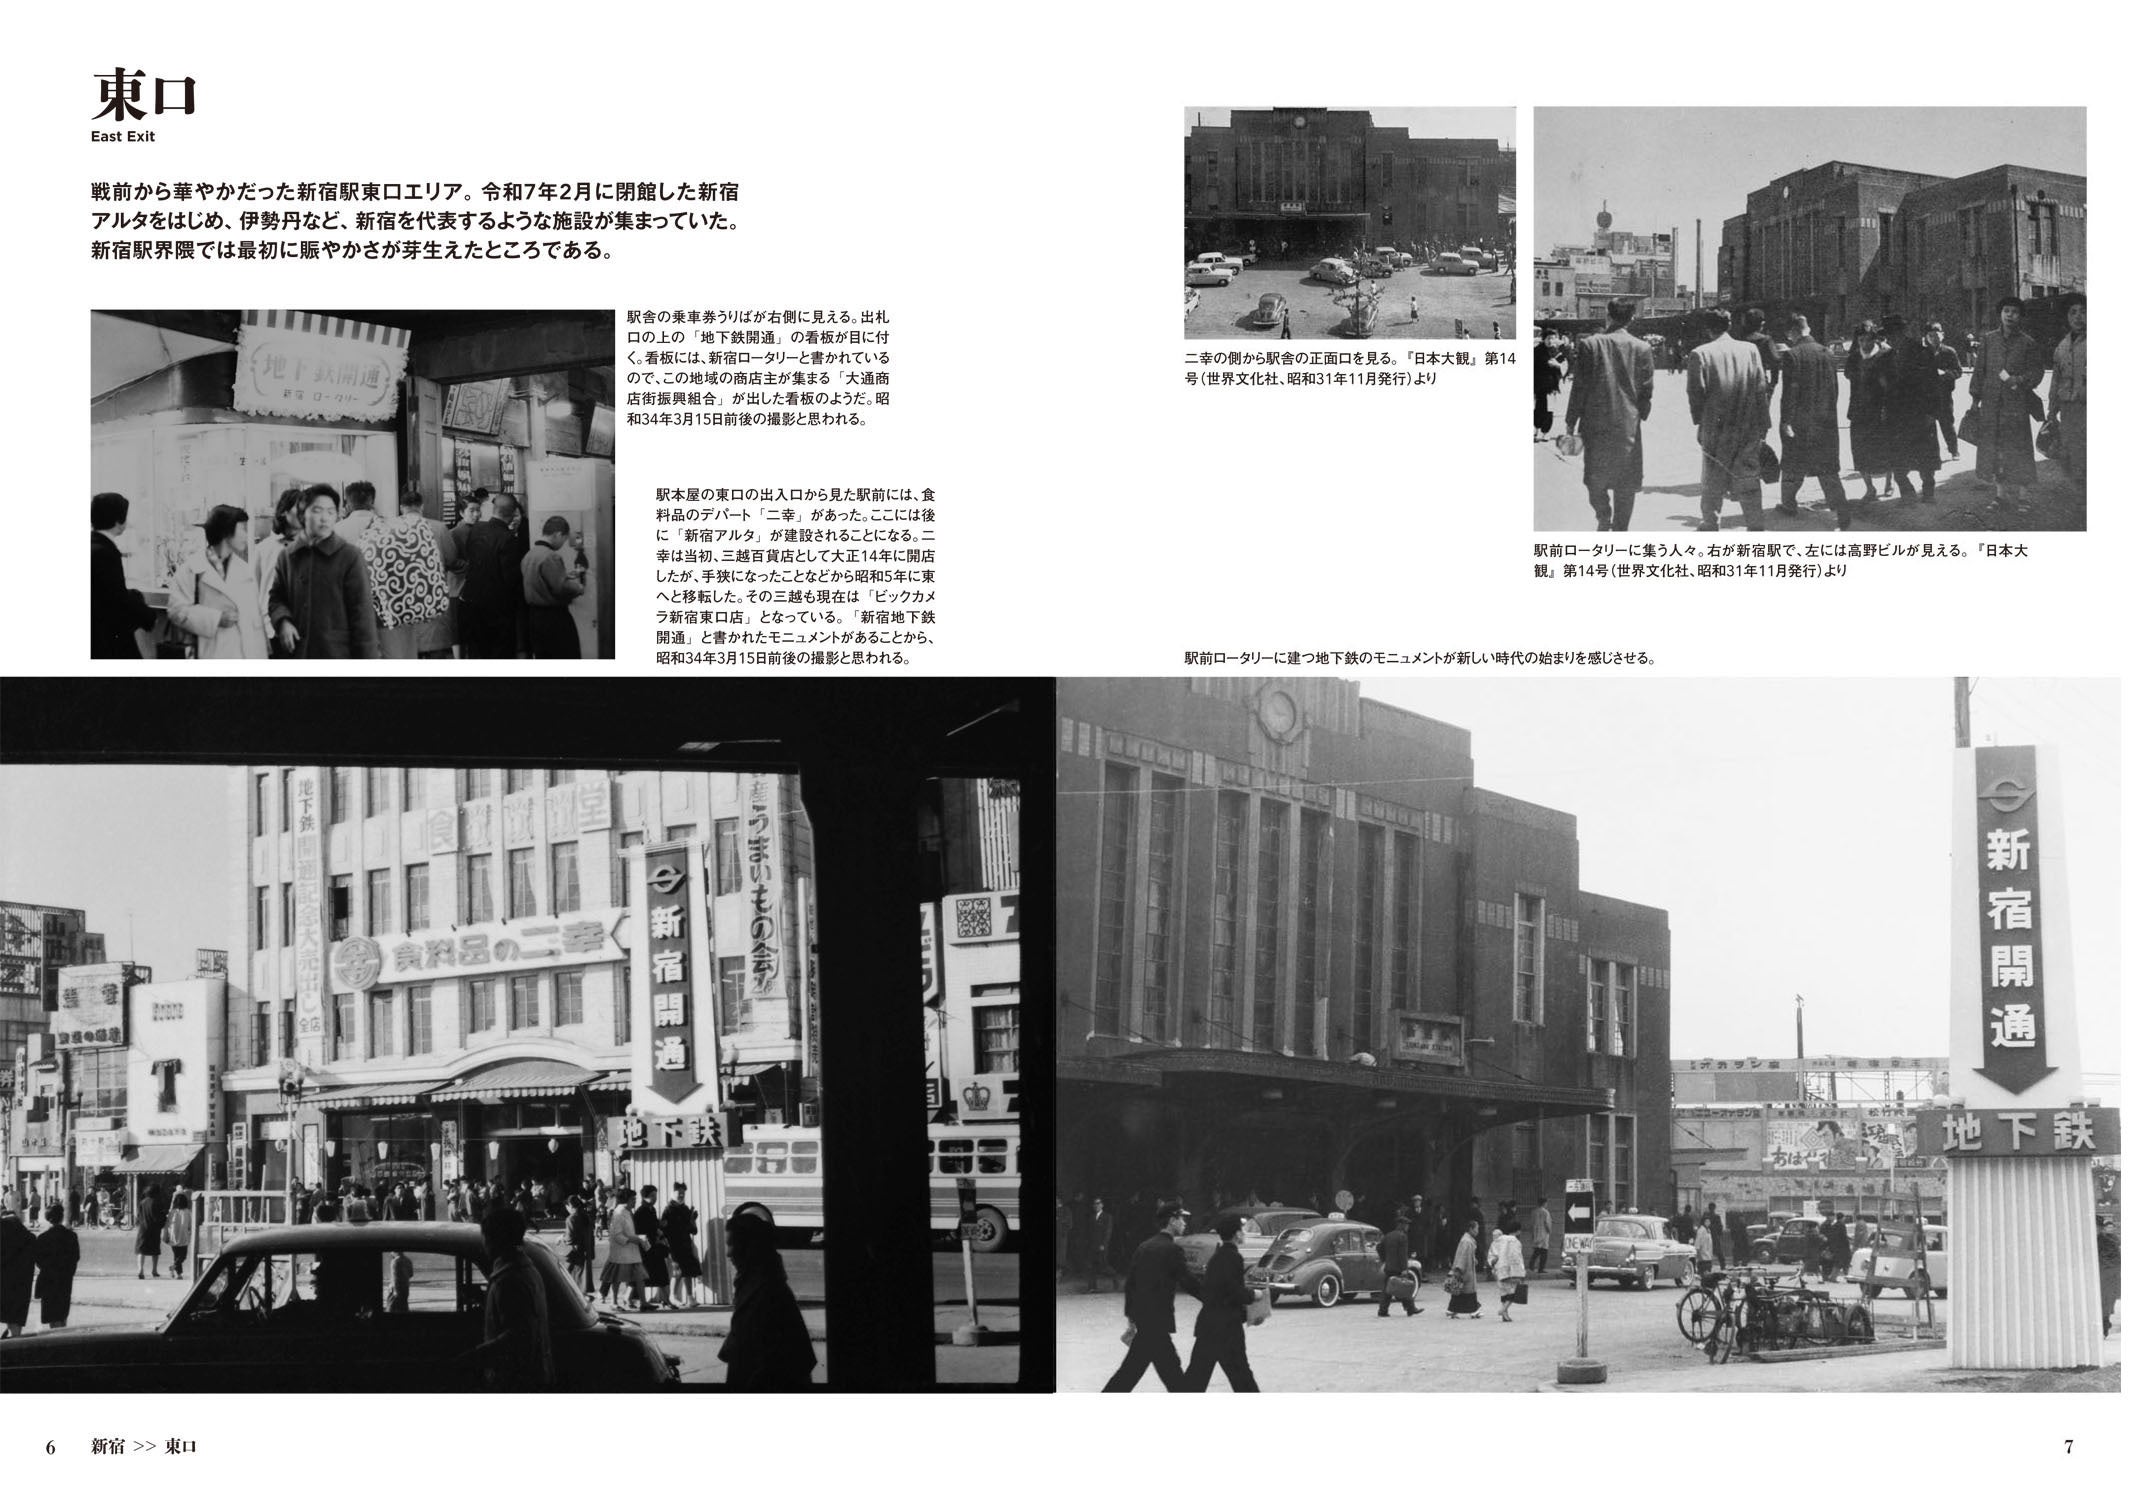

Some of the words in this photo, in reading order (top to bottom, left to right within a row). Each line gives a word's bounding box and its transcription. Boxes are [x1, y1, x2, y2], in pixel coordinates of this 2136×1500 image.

[92, 67, 198, 121] 東口
[92, 131, 122, 142] East
[128, 131, 155, 142] Exit
[91, 210, 738, 231] アルタをはじめ、伊勢丹など、新宿を代表するような施設が集まっていた。
[91, 239, 612, 260] 新宿駅界隈では最初に賑やかさが芽生えたところである。
[626, 309, 890, 325] 駅舎の乗車券うりばが右側に見える。出札
[626, 350, 890, 365] く。看板には、新宿ロータリーと書かれている
[626, 411, 867, 427] 和34年3月15日前後の撮影と思われる。
[655, 487, 936, 503] 駅本屋の東口の出入口から見た駅前には、食
[656, 548, 936, 564] 幸は当初、三越百貨店として大正14年に開店
[656, 568, 936, 584] したが、手狭になったことなどから昭和5年に東
[656, 650, 911, 666] 昭和34年3月15日前後の撮影と思われる。
[1184, 650, 1655, 666] 駅前ロータリーに建つ地下鉄のモニュメントが新しい時代の始まりを感じさせる。
[1986, 828, 2037, 1049] 新宿開通
[650, 903, 690, 1071] 新宿開通
[615, 1116, 722, 1149] 地下鉄
[1941, 1110, 2097, 1152] 地下鉄
[45, 1439, 56, 1455] 6
[91, 1437, 126, 1455] 新宿
[165, 1437, 197, 1455] 東口
[2064, 1439, 2074, 1454] 7
